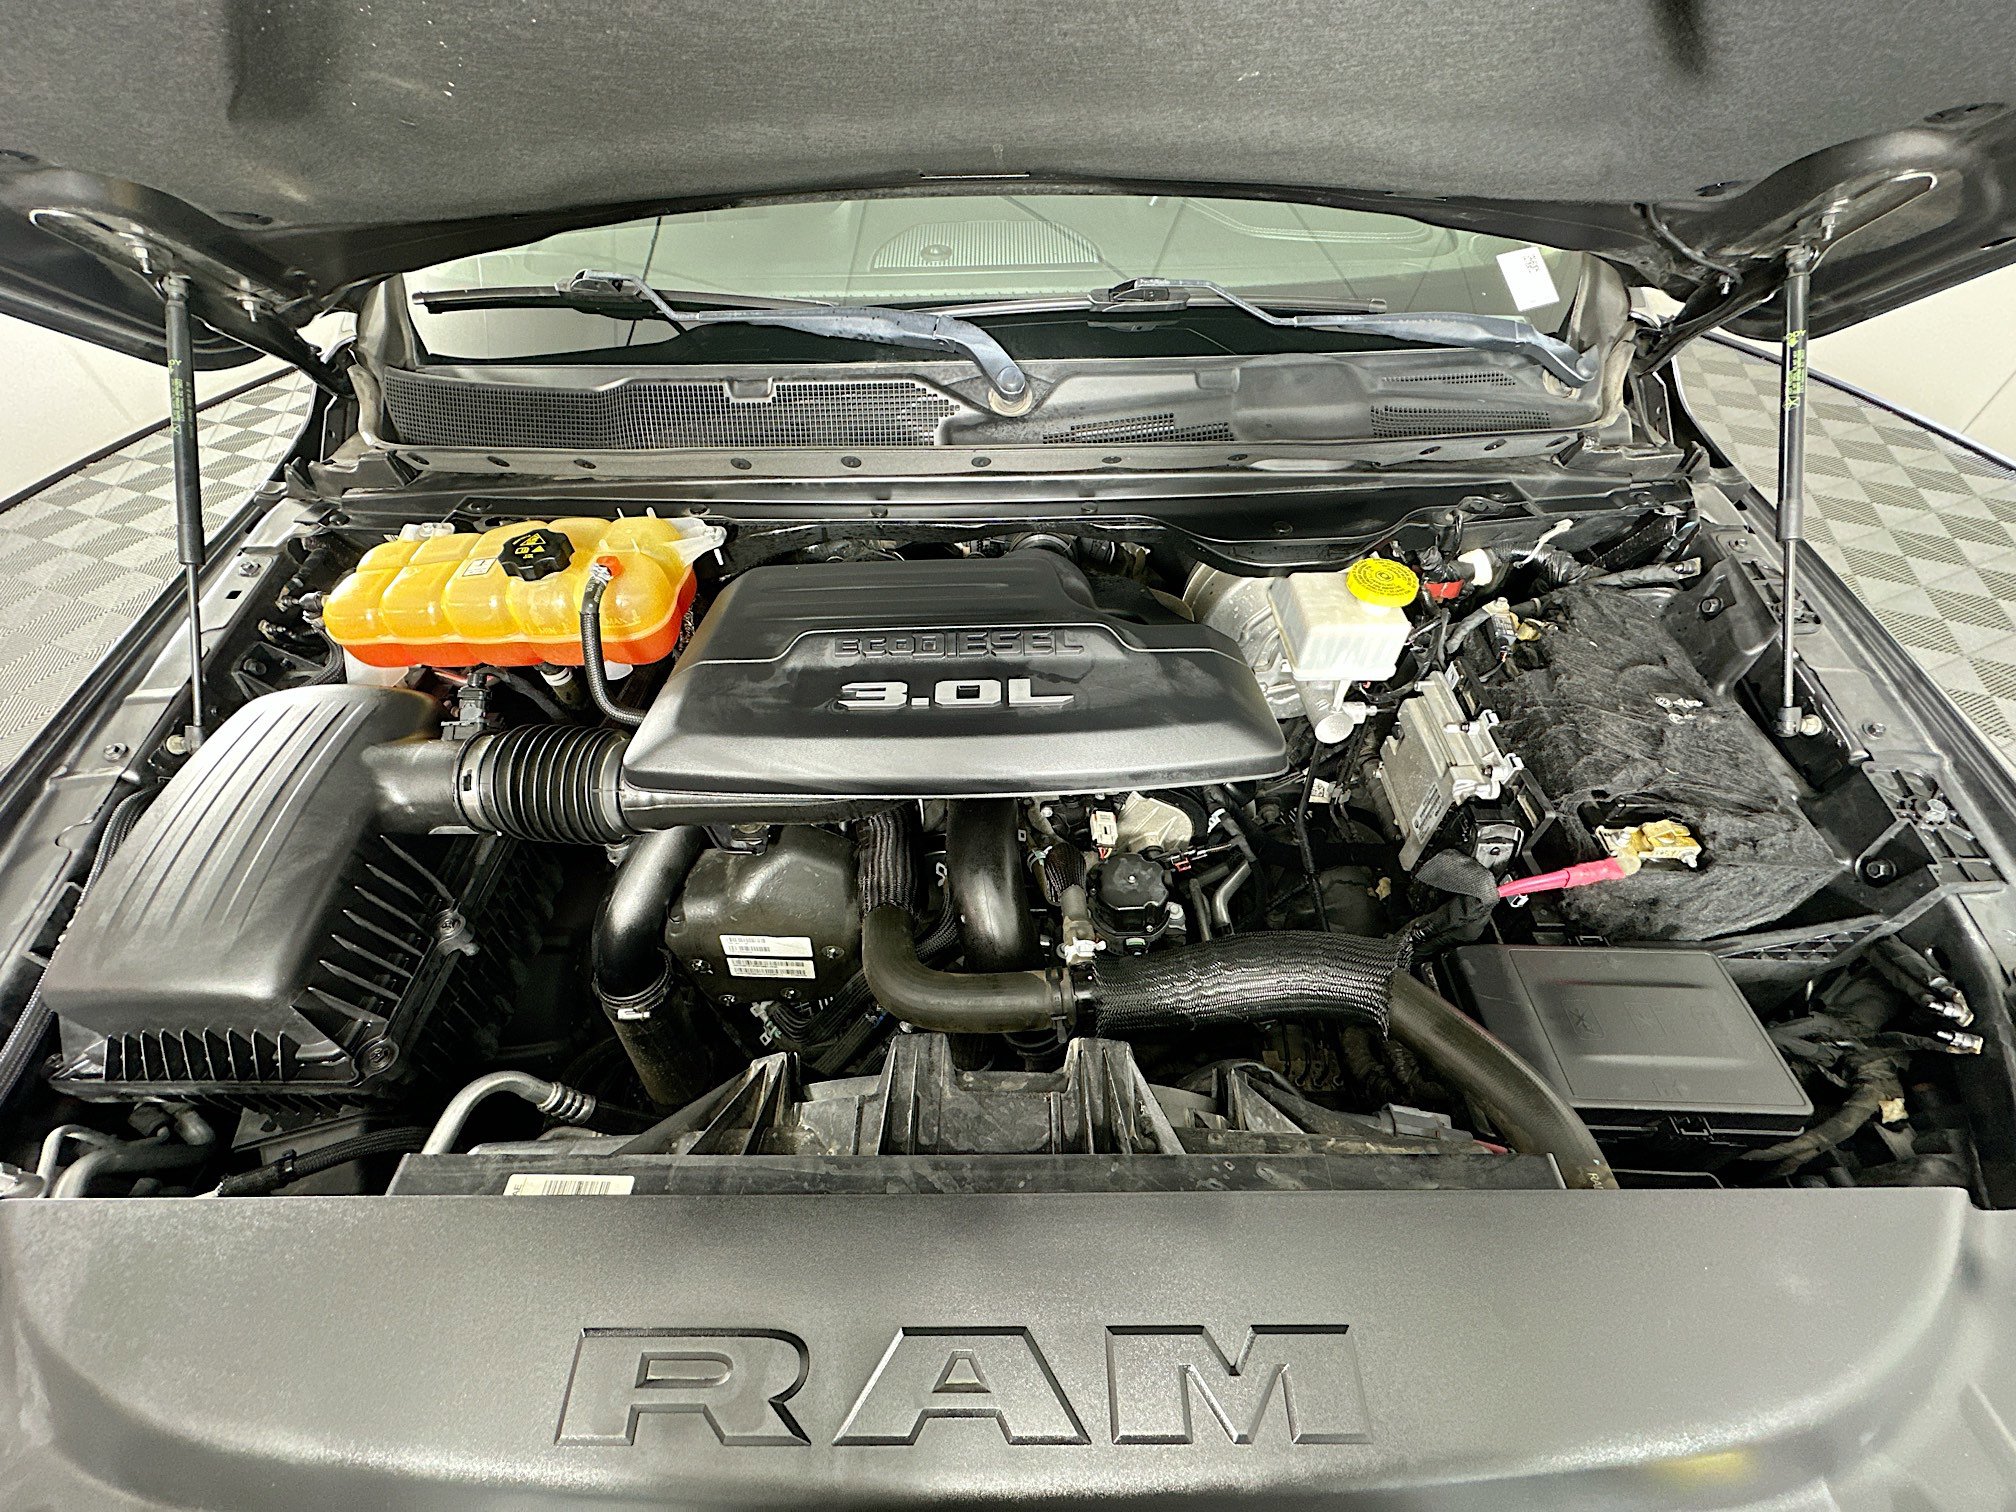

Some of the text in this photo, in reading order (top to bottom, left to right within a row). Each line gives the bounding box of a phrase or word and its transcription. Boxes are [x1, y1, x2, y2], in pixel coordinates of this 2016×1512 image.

[834, 629, 1085, 659] ECODIESEL
[838, 677, 1075, 711] 3.0L
[553, 1324, 1373, 1446] RAM
